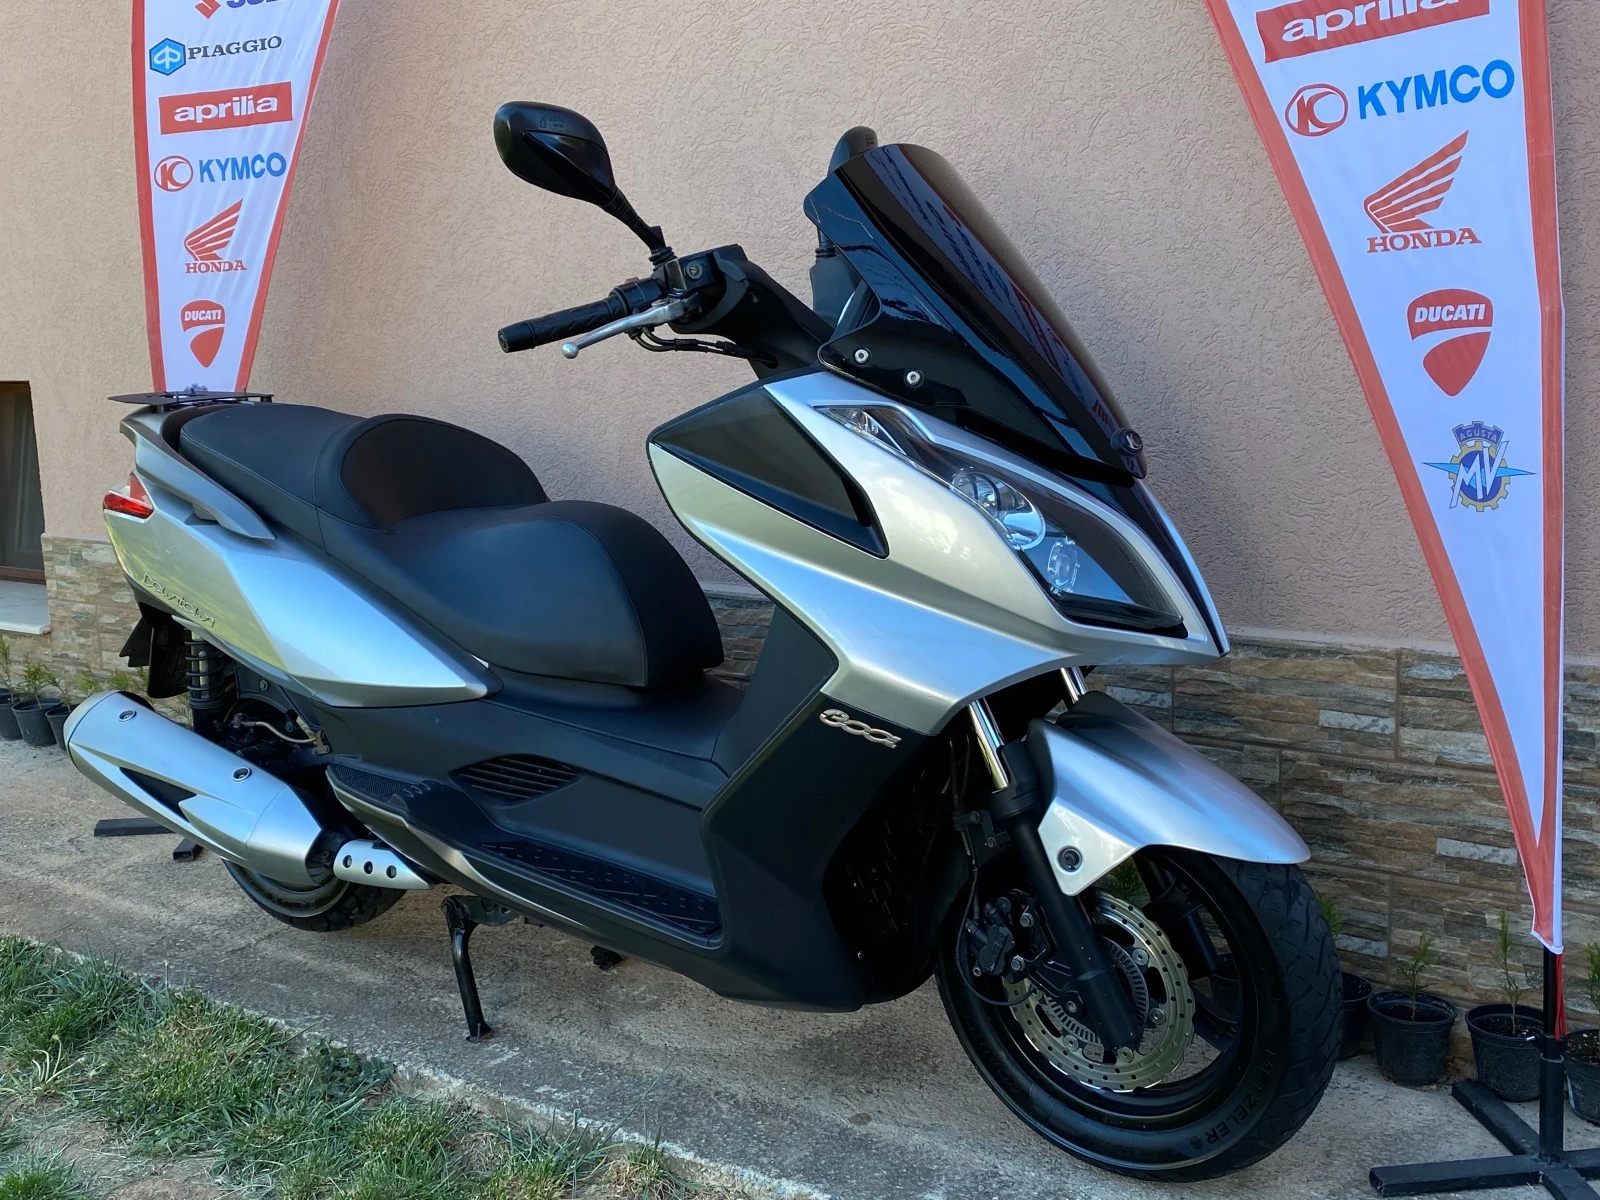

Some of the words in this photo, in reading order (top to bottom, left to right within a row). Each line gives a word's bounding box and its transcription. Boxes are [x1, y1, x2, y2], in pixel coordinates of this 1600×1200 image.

[187, 35, 282, 60] PIAGGIO
[1358, 59, 1515, 119] KYMCO
[173, 94, 279, 123] aprilia
[198, 151, 287, 183] KYMCO
[1367, 227, 1482, 253] HONDA
[184, 259, 247, 274] HONDA
[184, 309, 222, 323] DUCATI
[1415, 303, 1486, 323] DUCATI
[1459, 428, 1499, 443] AGUSTA
[1449, 440, 1510, 510] MV
